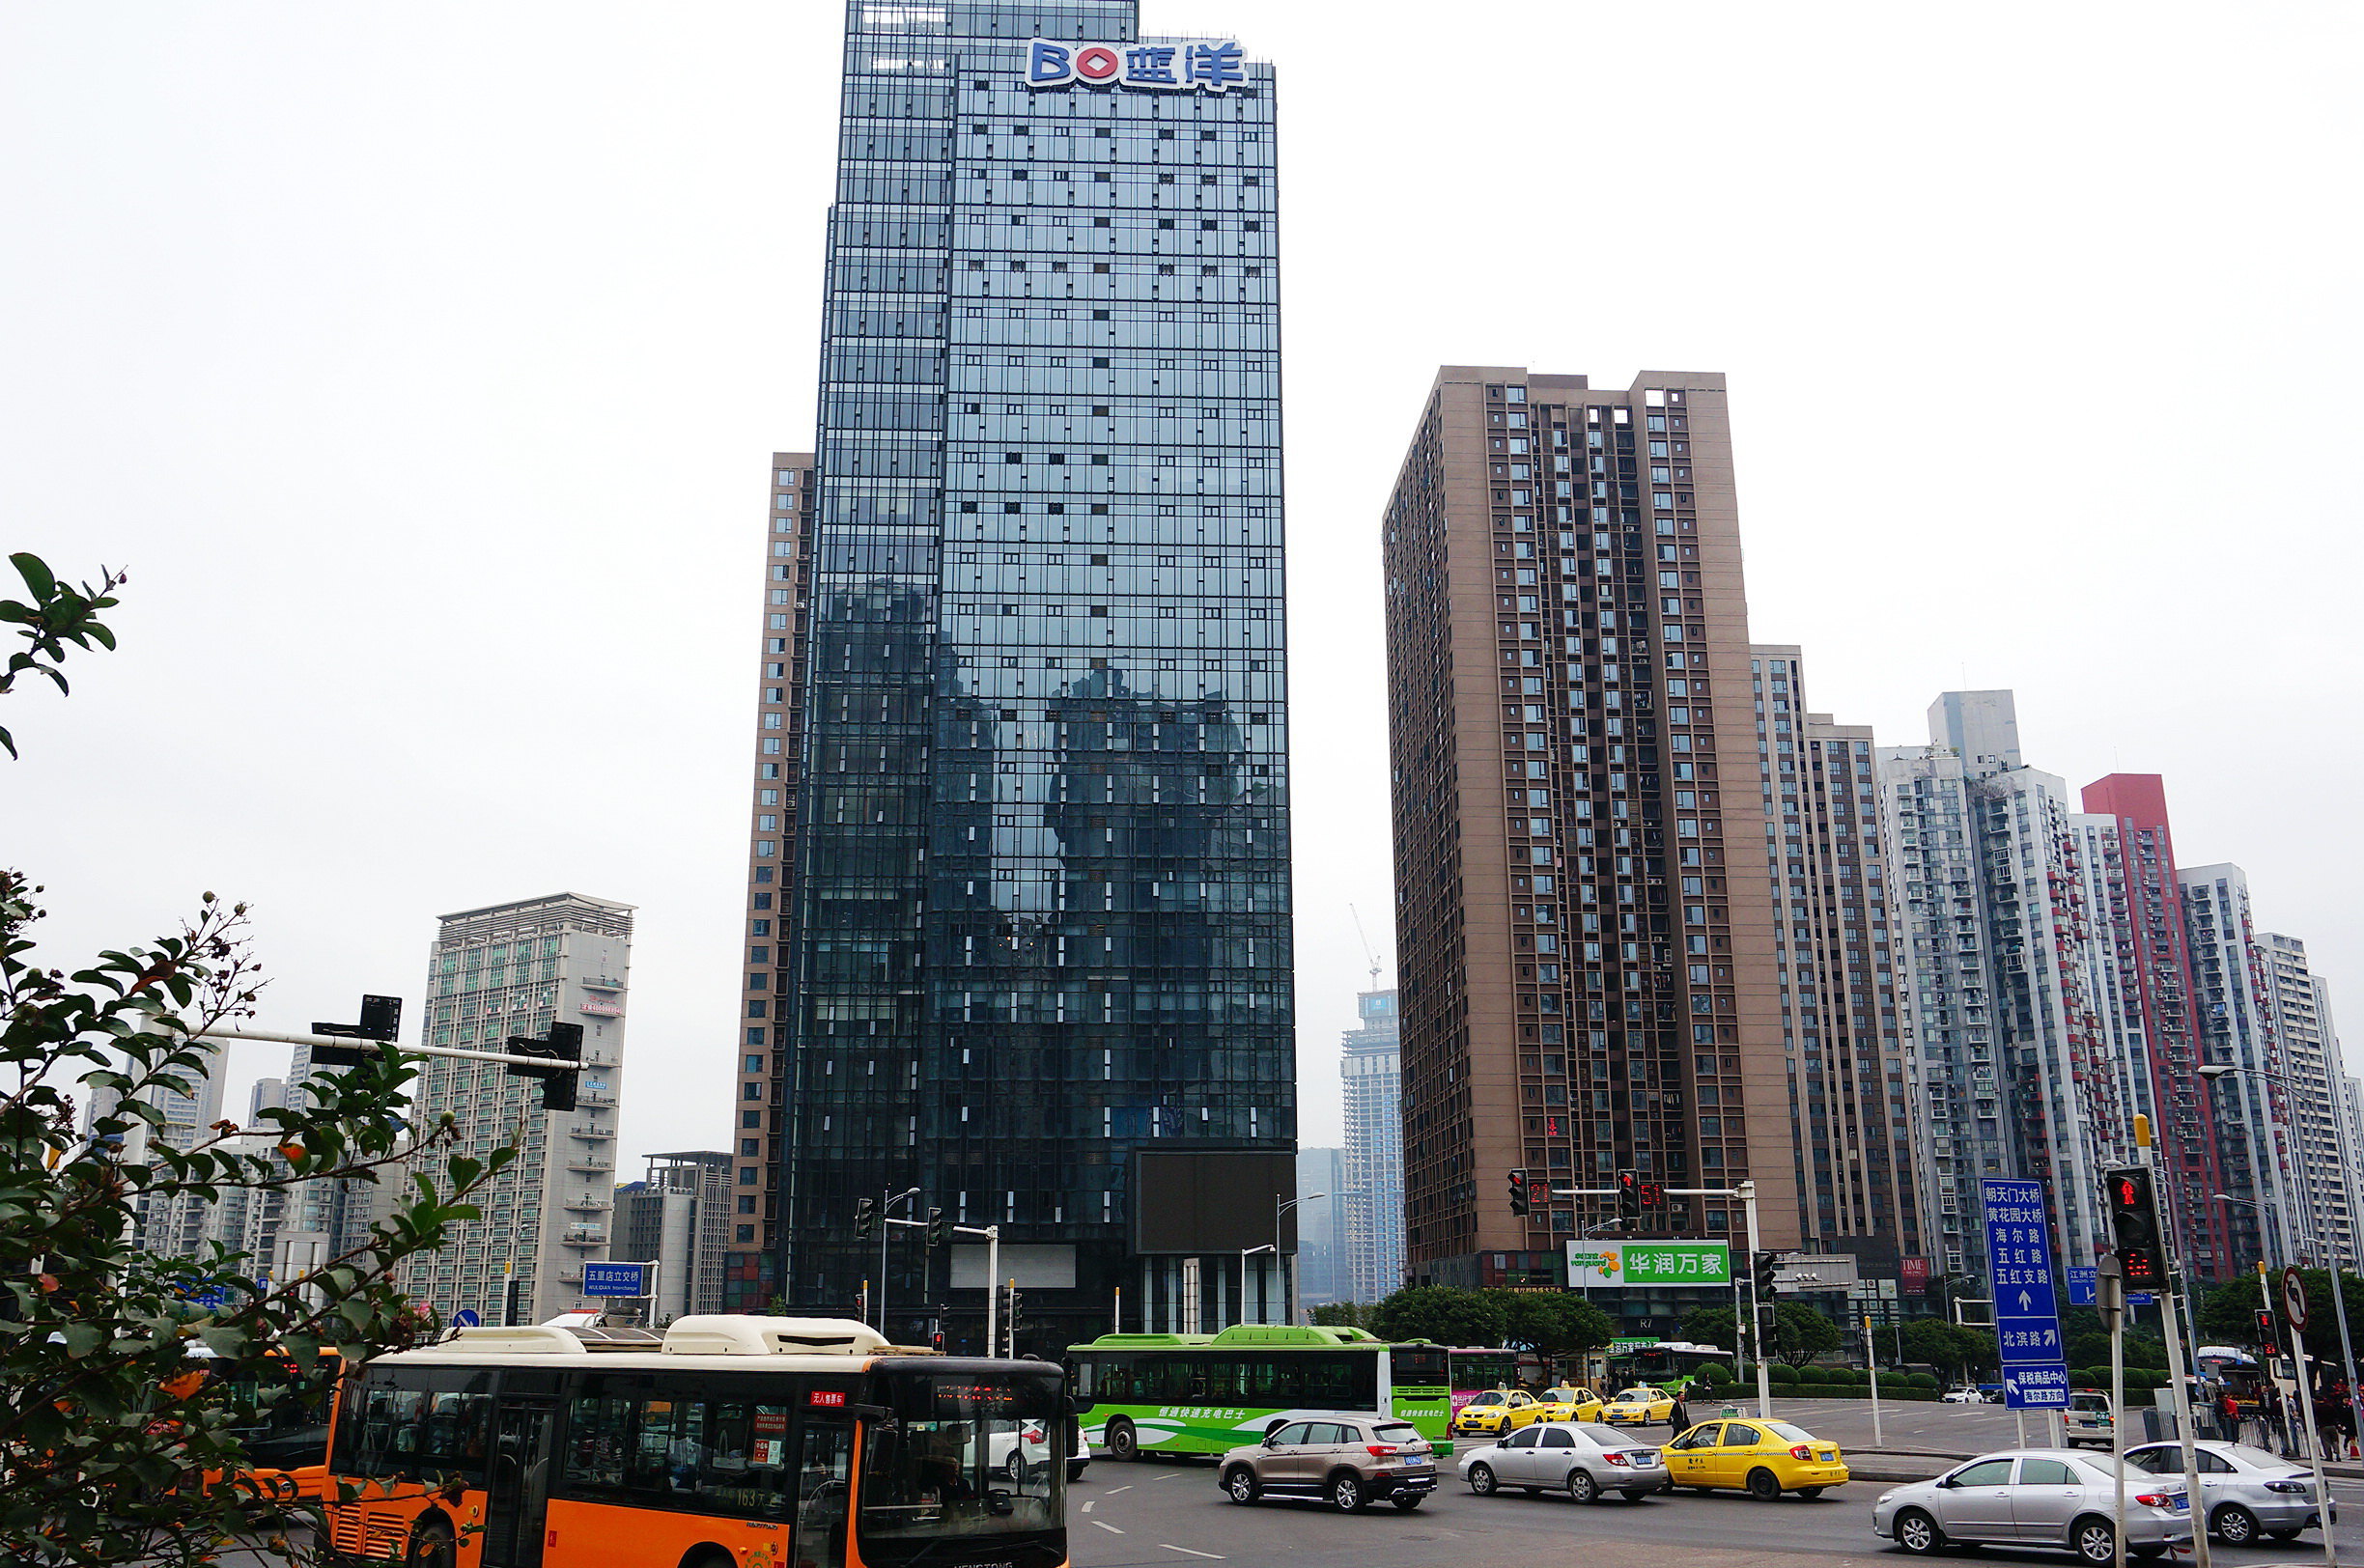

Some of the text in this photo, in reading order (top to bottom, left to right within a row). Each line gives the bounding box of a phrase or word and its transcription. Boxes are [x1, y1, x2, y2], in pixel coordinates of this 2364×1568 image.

[1126, 42, 1244, 86] 蓝洋
[1984, 1187, 2040, 1204] 朝天门大桥
[1987, 1207, 2043, 1224] 黄花园大桥
[1995, 1227, 2040, 1244] 海尔路
[1628, 1252, 1724, 1275] 华润万家
[1998, 1248, 2042, 1264] 五红路
[1900, 1259, 1924, 1271] TIME
[588, 1271, 638, 1282] 五里店立交桥
[1997, 1269, 2048, 1284] 五红支路
[1640, 1319, 1652, 1329] R7
[2003, 1330, 2041, 1347] 北滨路
[2017, 1371, 2067, 1386] 保税商品中心
[813, 1393, 843, 1405] 无人售票车
[2025, 1390, 2064, 1401] 海尔路方向
[1158, 1407, 1246, 1419] 恒通快速充电巴士
[737, 1488, 756, 1506] 163
